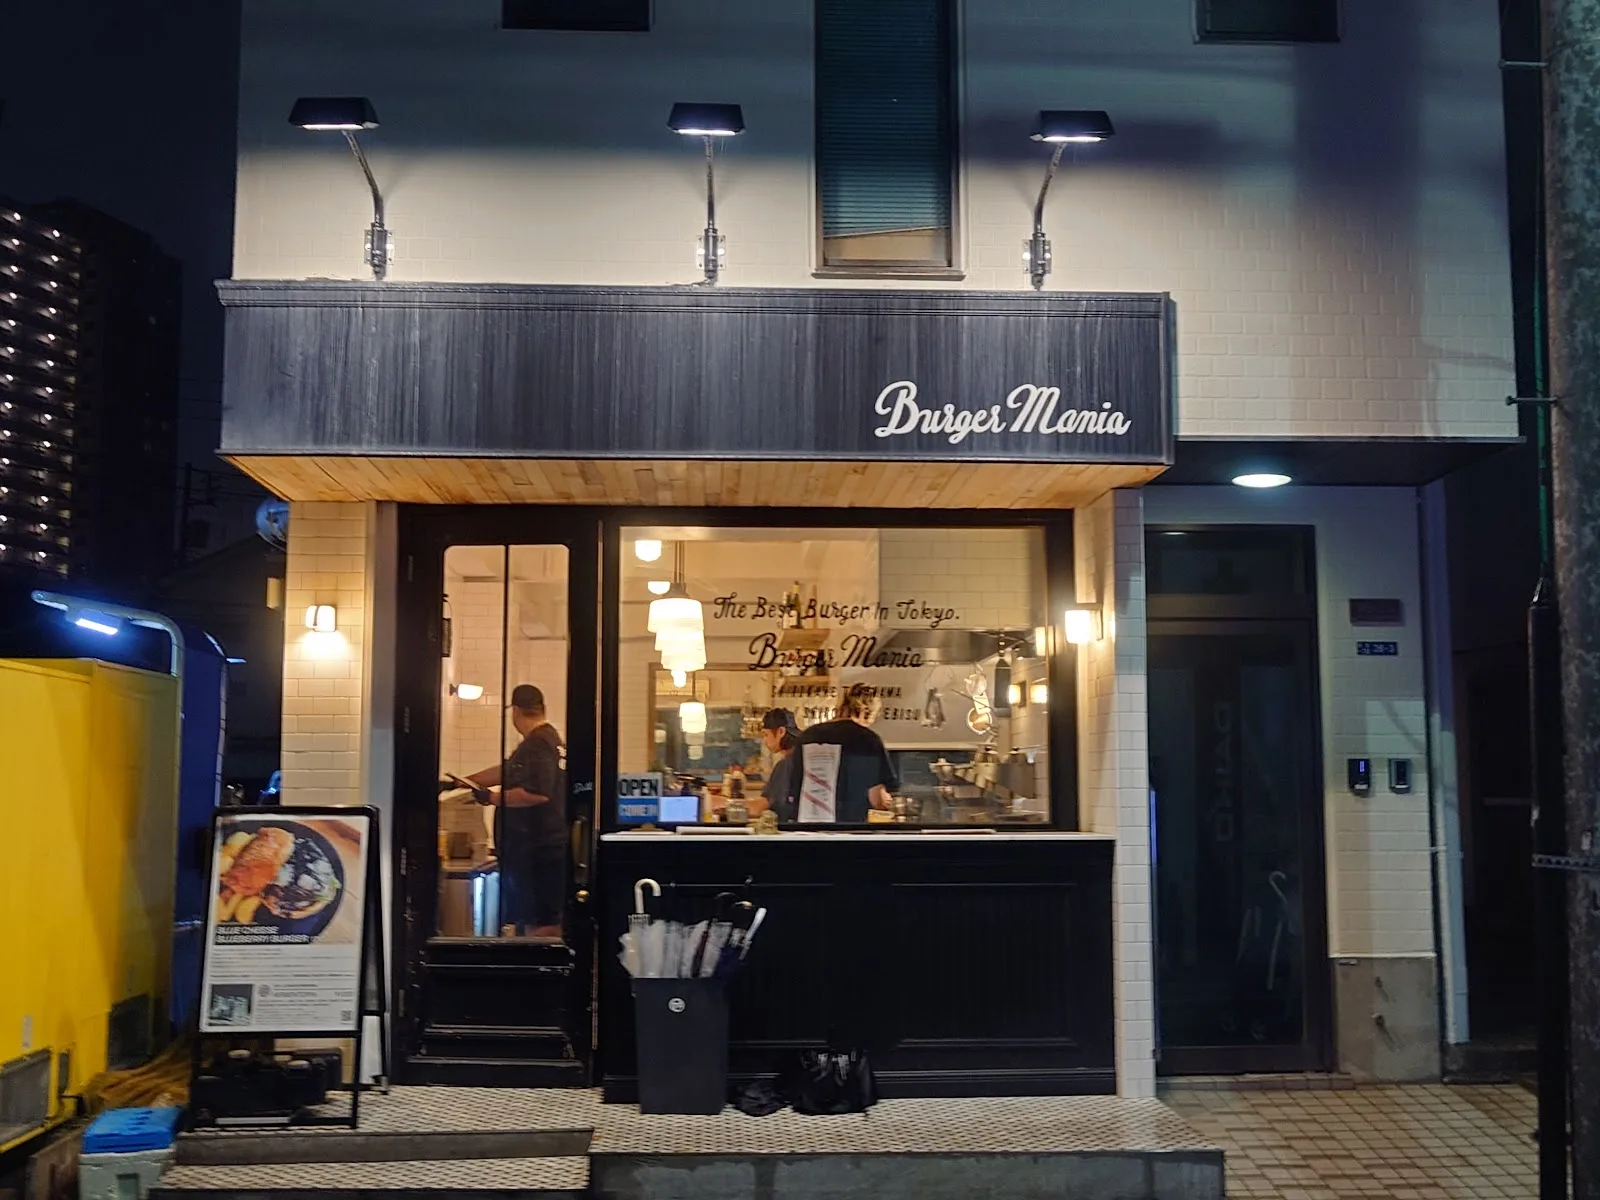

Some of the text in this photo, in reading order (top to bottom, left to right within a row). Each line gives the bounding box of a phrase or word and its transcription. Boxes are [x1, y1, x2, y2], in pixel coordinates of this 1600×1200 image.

[874, 380, 1132, 444] Burger Mania
[713, 591, 960, 628] The Best Burger In Tokyo.
[748, 632, 923, 675] Burger Mania
[619, 778, 658, 797] OPEN
